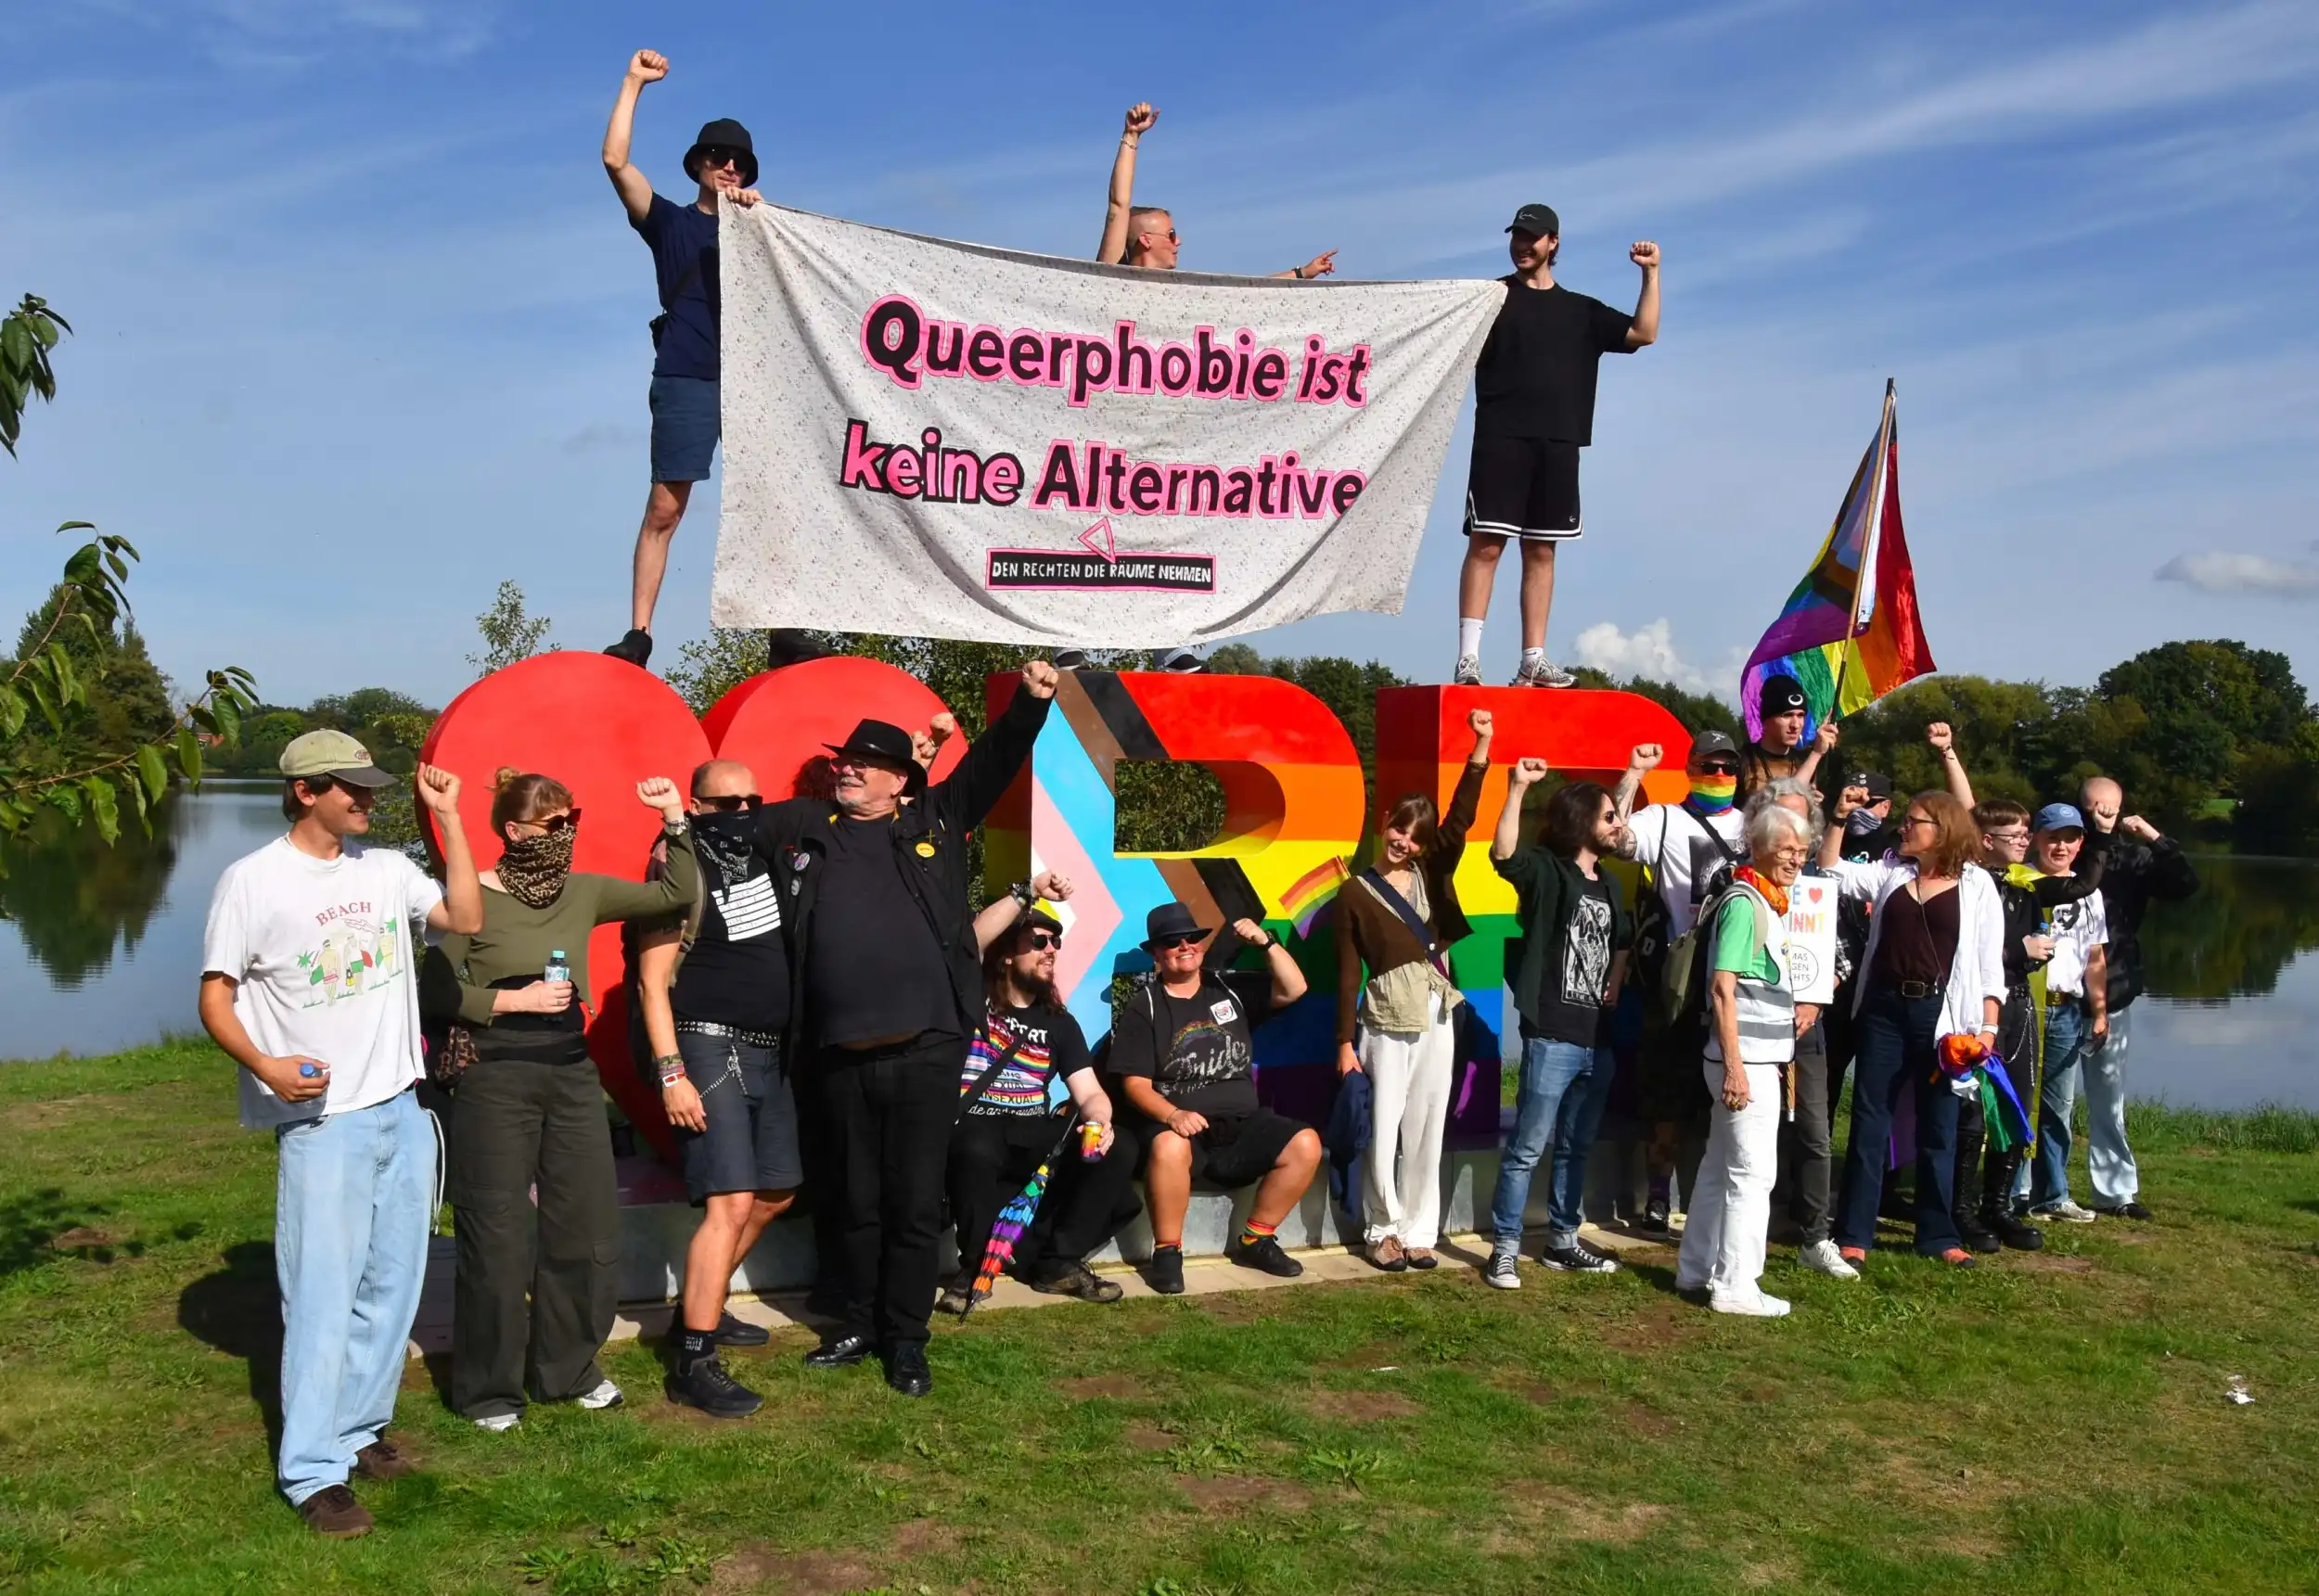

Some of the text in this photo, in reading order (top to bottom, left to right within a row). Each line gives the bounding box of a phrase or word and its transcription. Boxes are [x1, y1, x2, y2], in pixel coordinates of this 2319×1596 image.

[861, 294, 1371, 408] Queerphobie ist
[840, 418, 1368, 519] keine Alternative
[992, 560, 1211, 582] DEN RECHTEN DIE RÄUME NEHMEN
[315, 901, 371, 926] BEACH
[1788, 910, 1826, 935] INNT
[1792, 963, 1809, 971] GEN
